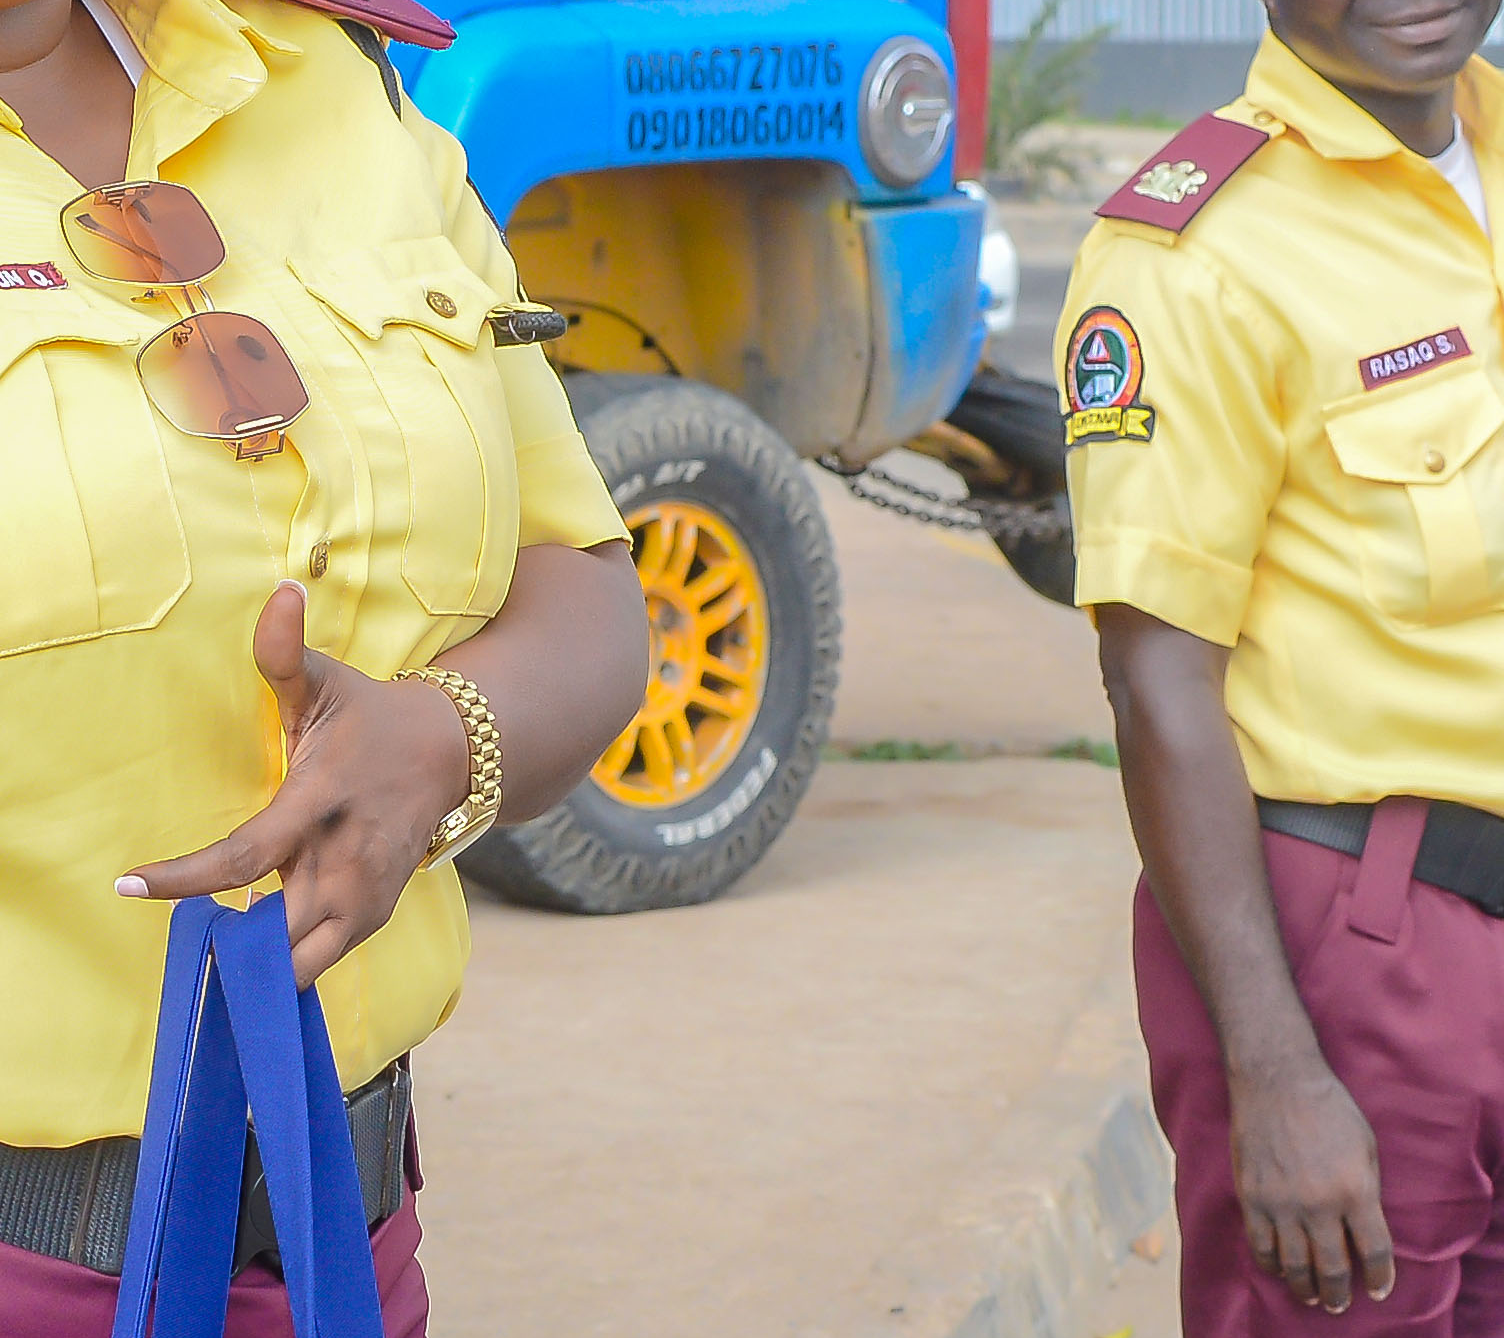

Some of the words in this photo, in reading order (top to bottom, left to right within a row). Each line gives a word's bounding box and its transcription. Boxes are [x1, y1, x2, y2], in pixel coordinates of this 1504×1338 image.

[625, 41, 844, 94] 08066727076
[628, 101, 845, 151] 09018060014
[1370, 341, 1435, 379] RASAQ
